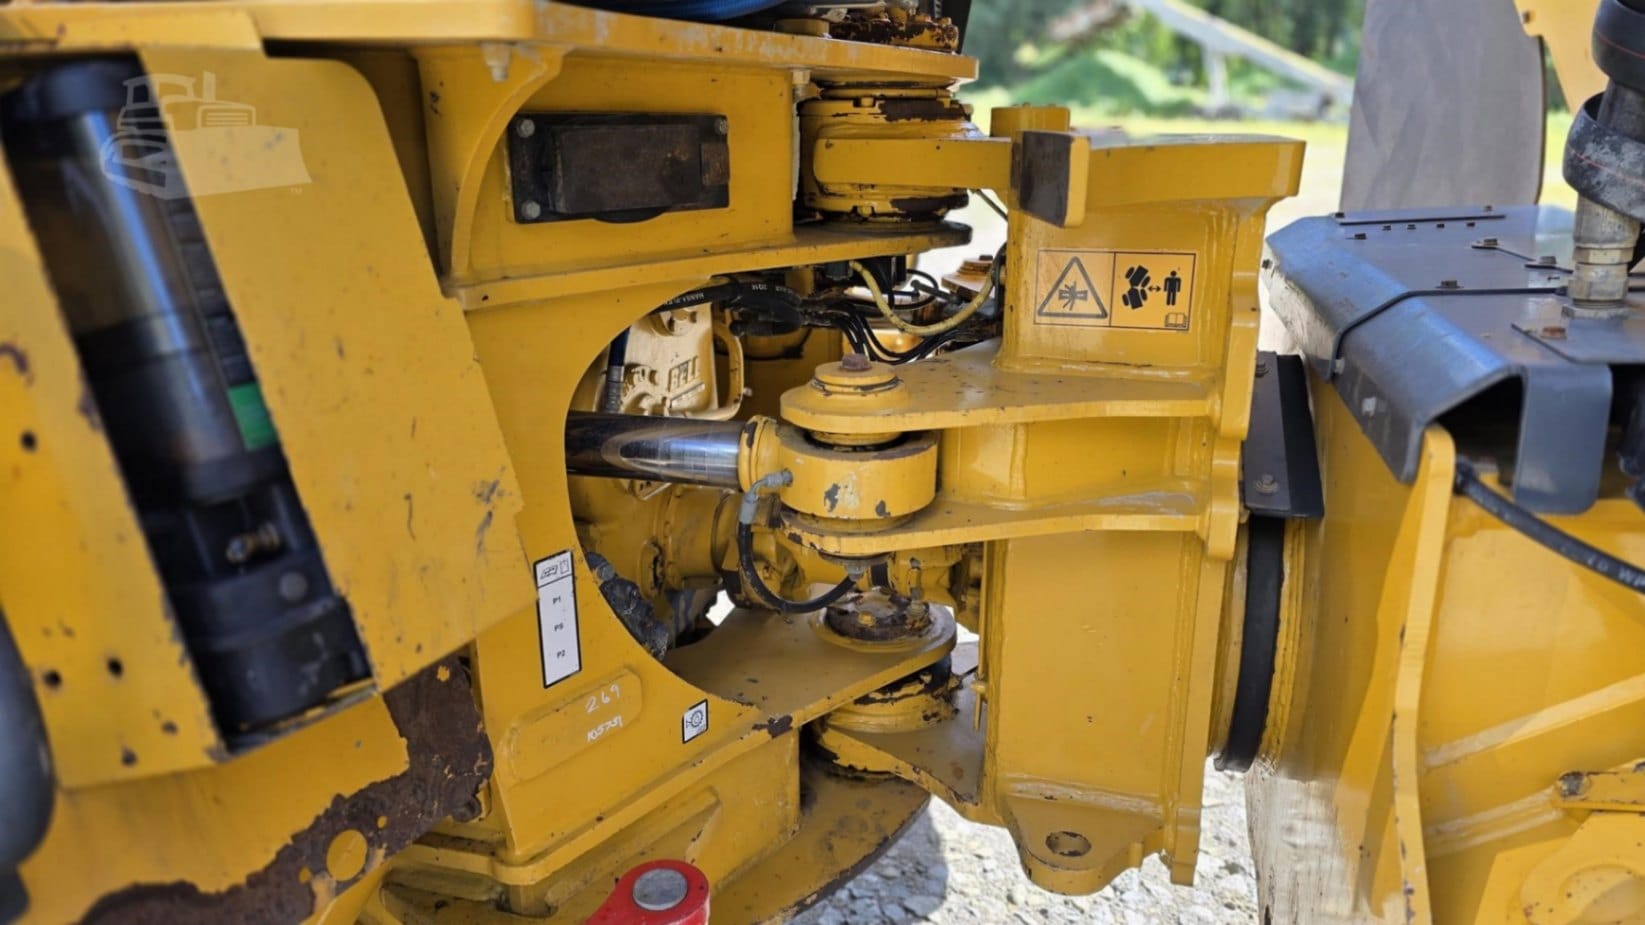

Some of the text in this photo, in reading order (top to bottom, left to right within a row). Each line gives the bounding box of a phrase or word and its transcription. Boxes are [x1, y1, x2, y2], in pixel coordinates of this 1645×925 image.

[667, 355, 699, 392] BELL
[552, 595, 562, 605] P1
[556, 649, 566, 659] P2
[584, 683, 621, 713] 269
